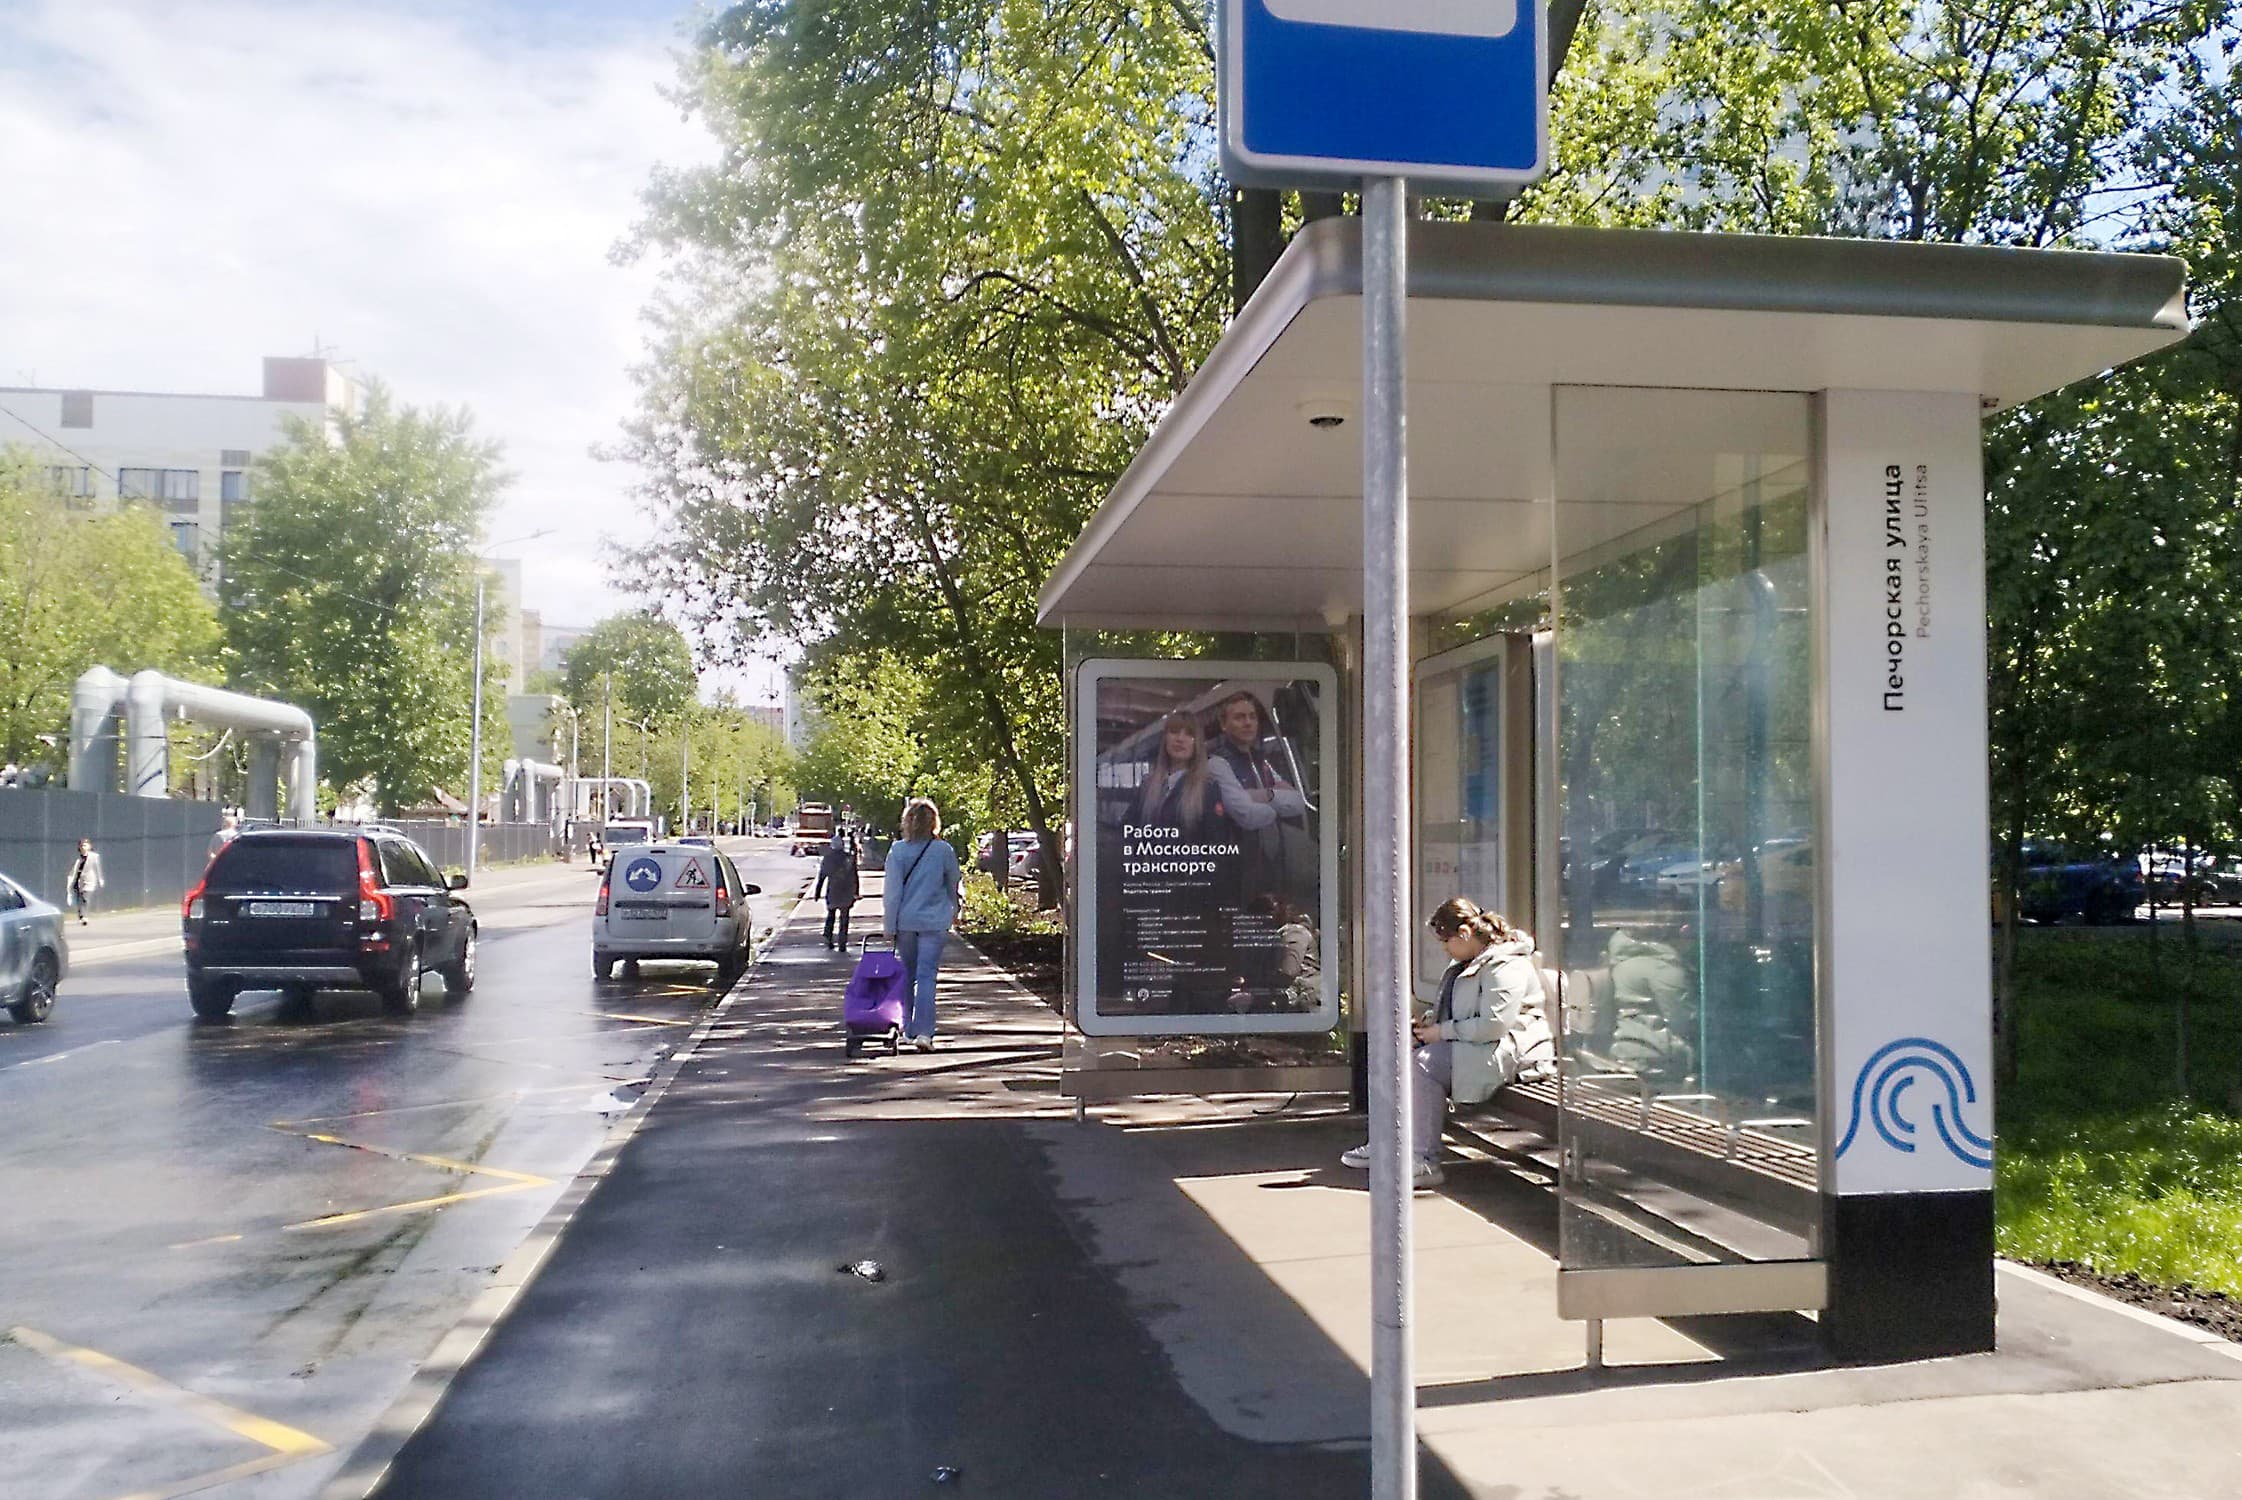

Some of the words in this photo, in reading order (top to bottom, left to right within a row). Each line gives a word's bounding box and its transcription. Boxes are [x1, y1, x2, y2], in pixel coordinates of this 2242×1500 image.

[1885, 464, 1907, 548] улица
[1914, 464, 1929, 518] Ulitsa
[1915, 523, 1932, 639] Pechorskaya
[1884, 558, 1906, 712] Печорская
[1123, 824, 1179, 838] Работа
[1123, 845, 1132, 855] в
[1136, 841, 1239, 855] Московском
[1122, 862, 1216, 876] транспорте
